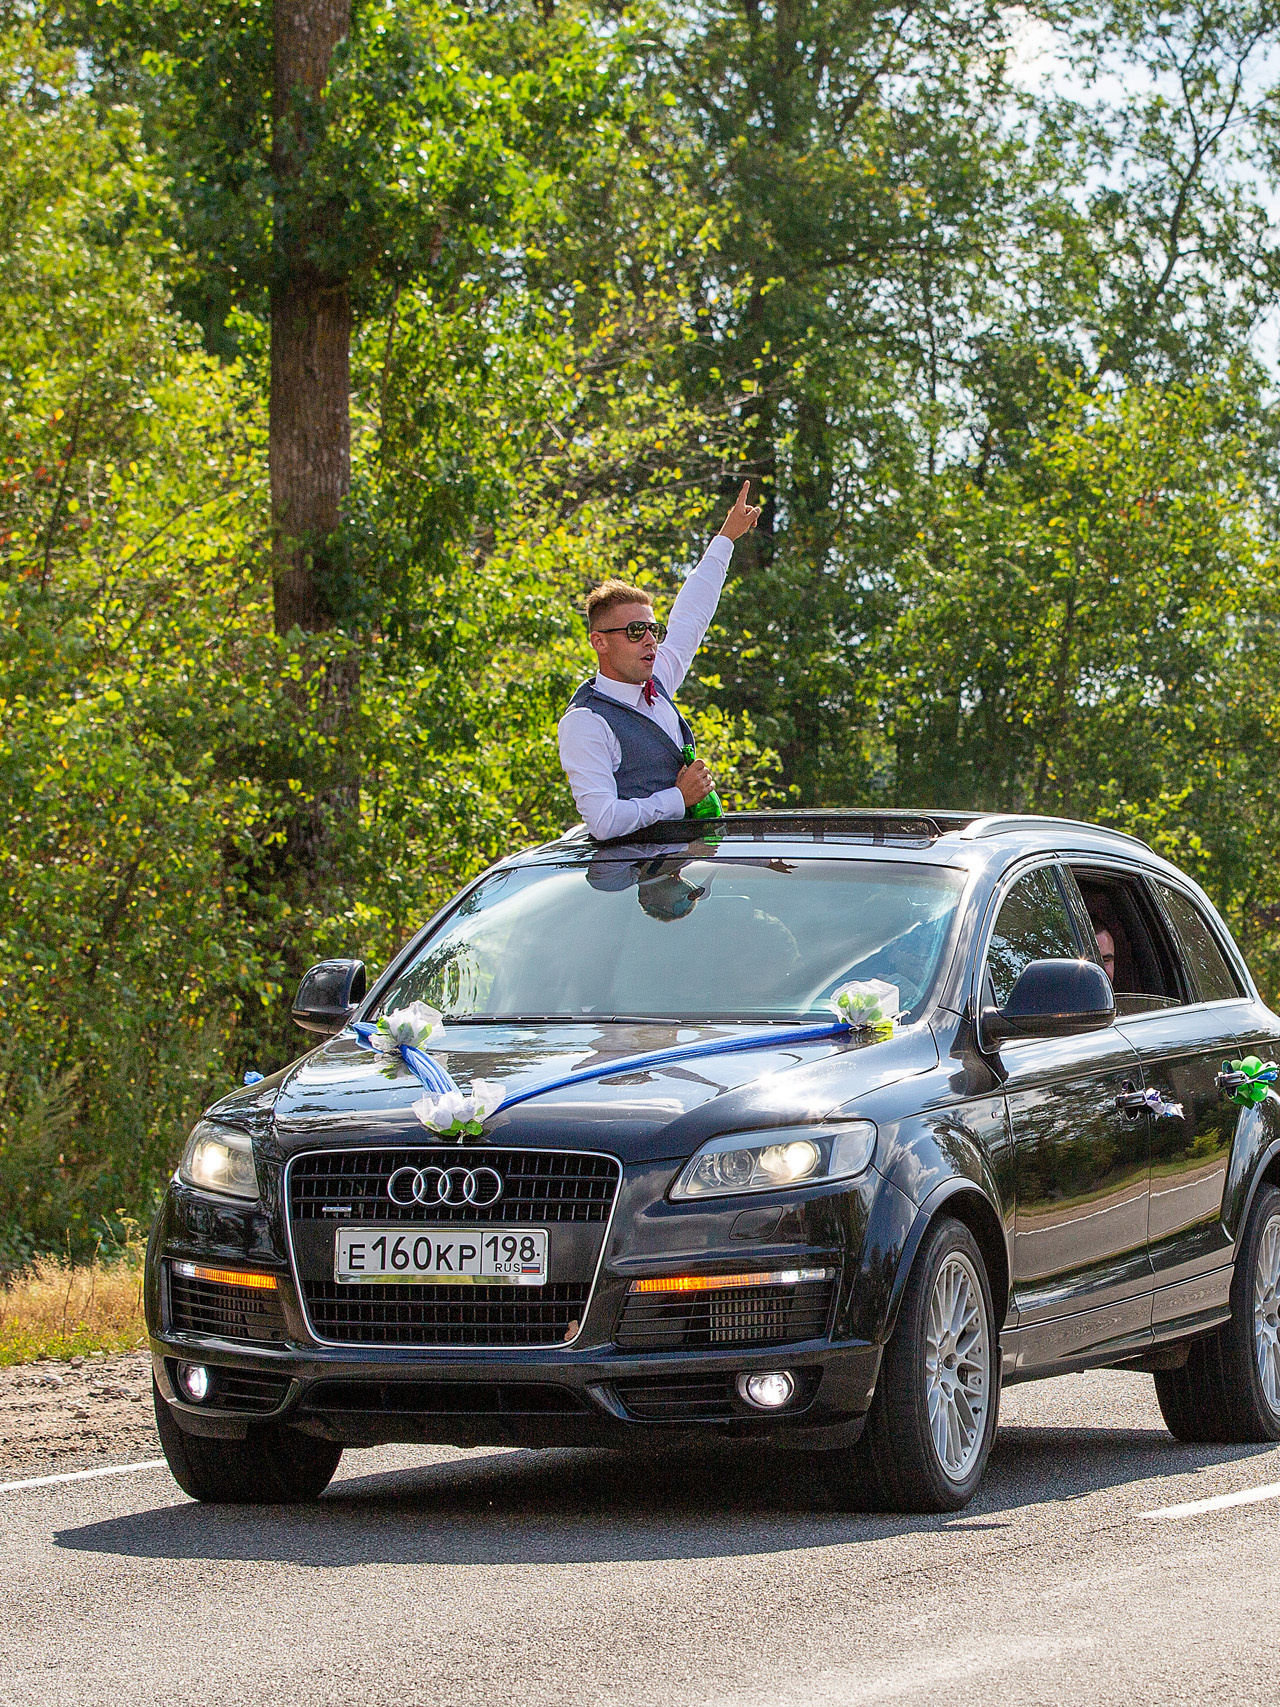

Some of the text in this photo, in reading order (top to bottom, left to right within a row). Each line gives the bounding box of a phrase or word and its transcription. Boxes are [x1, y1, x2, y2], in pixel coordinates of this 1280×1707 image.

[348, 1236, 535, 1271] E160KP 198
[494, 1263, 521, 1273] RUS
